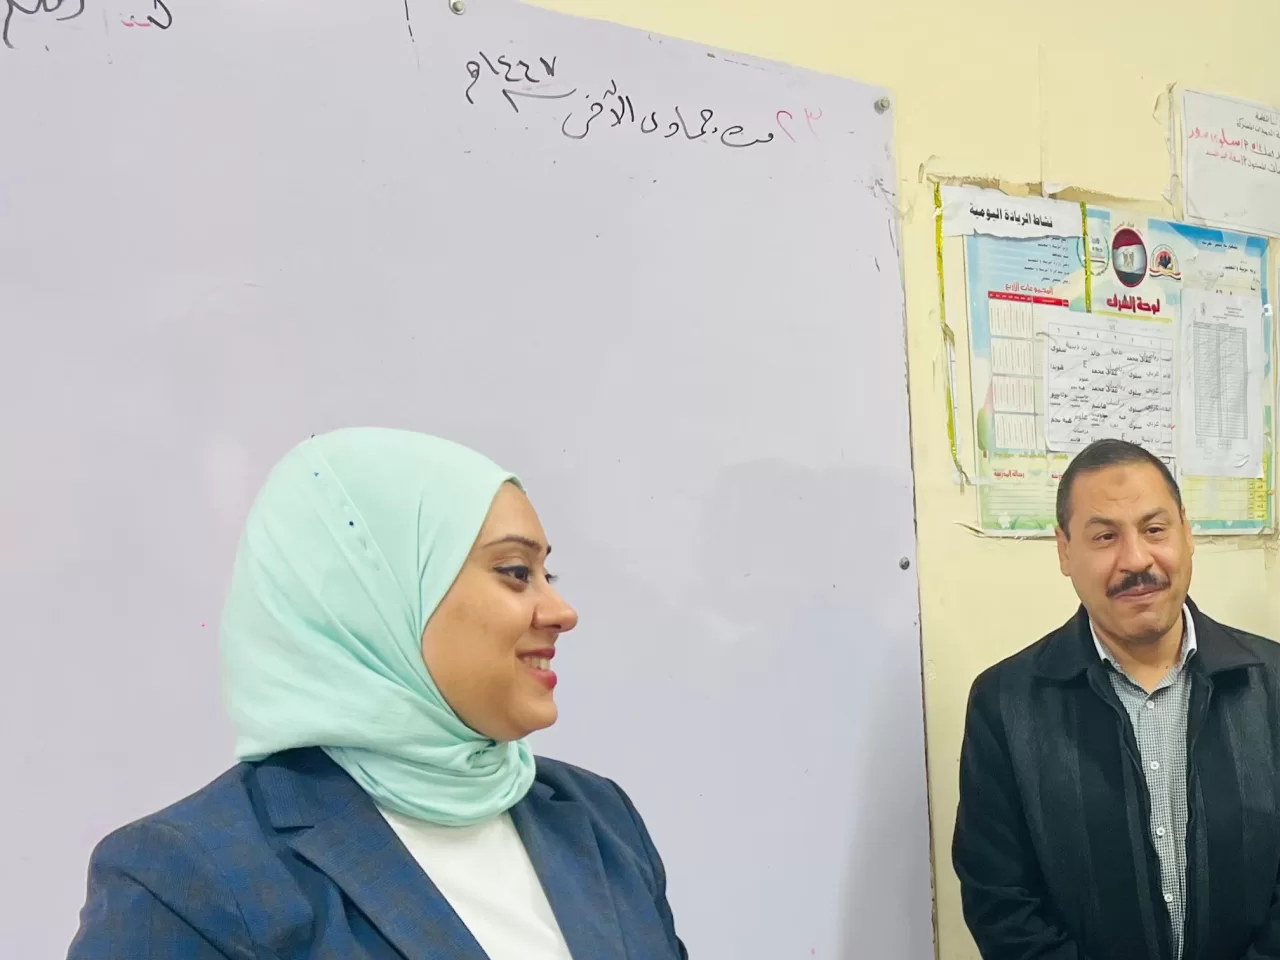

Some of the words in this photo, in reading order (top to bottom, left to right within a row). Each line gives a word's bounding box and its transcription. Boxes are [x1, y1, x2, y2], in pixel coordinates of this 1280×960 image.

[969, 202, 1002, 221] اليومية
[1004, 209, 1031, 226] الريادة
[1033, 213, 1053, 228] نشاط
[1106, 293, 1136, 314] الشرف
[1137, 298, 1161, 315] لوحة
